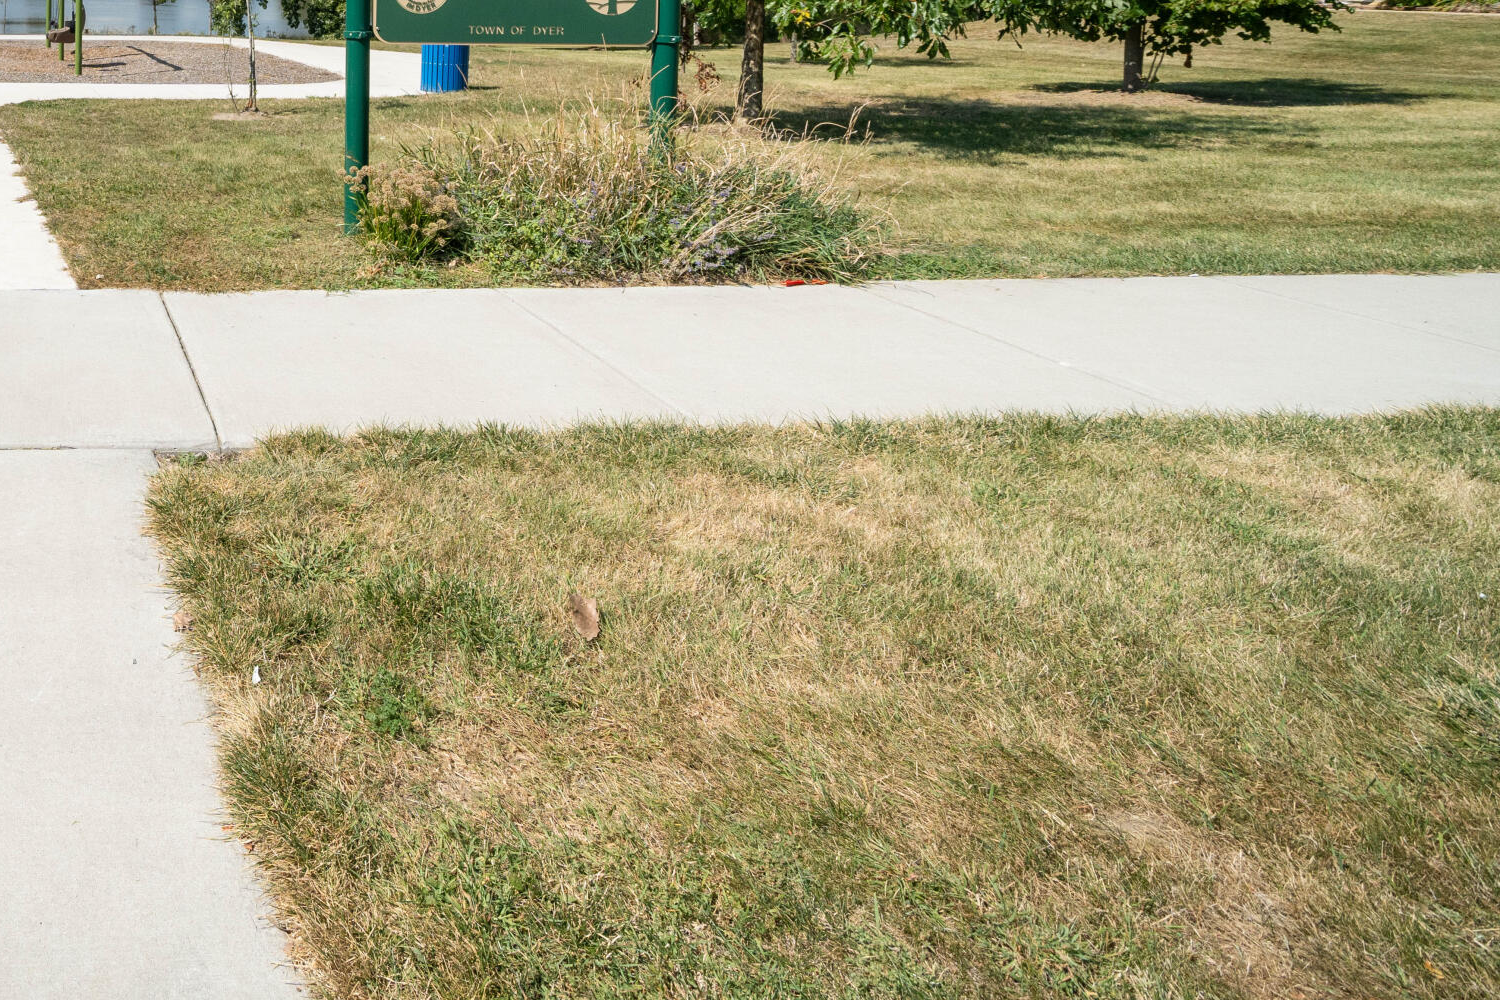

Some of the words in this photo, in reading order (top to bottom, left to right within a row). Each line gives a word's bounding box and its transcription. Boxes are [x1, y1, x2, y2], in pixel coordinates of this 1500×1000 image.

[468, 25, 505, 35] TOWN
[510, 25, 526, 35] OF
[533, 25, 565, 36] DYER
